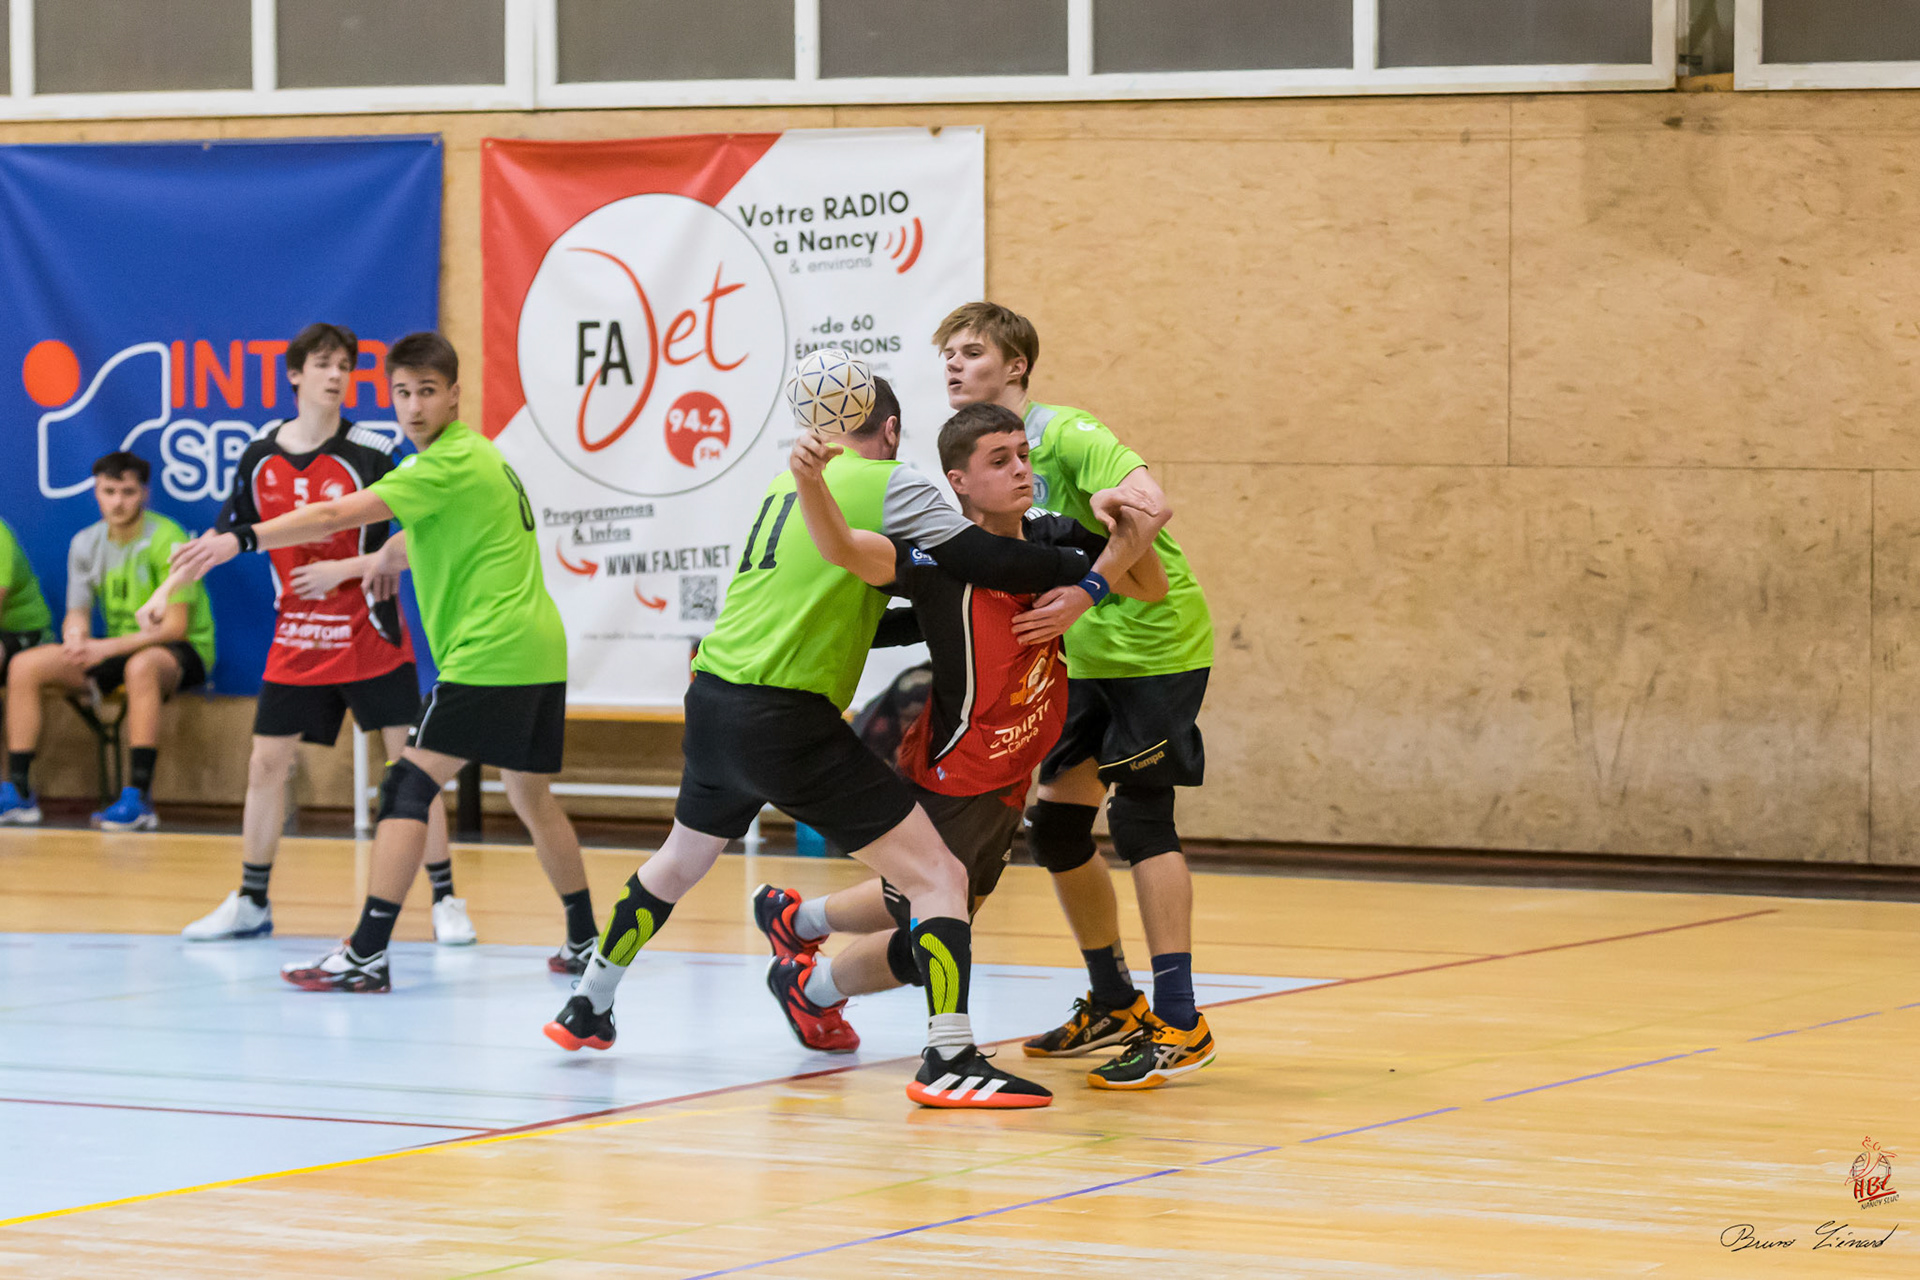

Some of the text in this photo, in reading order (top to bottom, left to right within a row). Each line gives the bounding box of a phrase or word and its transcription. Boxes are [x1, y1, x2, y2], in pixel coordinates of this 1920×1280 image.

[739, 191, 909, 228] Votre RADIO
[774, 230, 879, 254] à Nancy
[789, 256, 873, 274] & environs
[171, 339, 392, 408] INTR
[668, 408, 726, 434] 94.2
[699, 447, 721, 461] FM
[542, 503, 655, 525] Programmes
[590, 523, 632, 541] Infos
[738, 492, 800, 573] 11
[605, 544, 731, 577] WWW.FAJET.NET
[1130, 750, 1165, 771] Kempa
